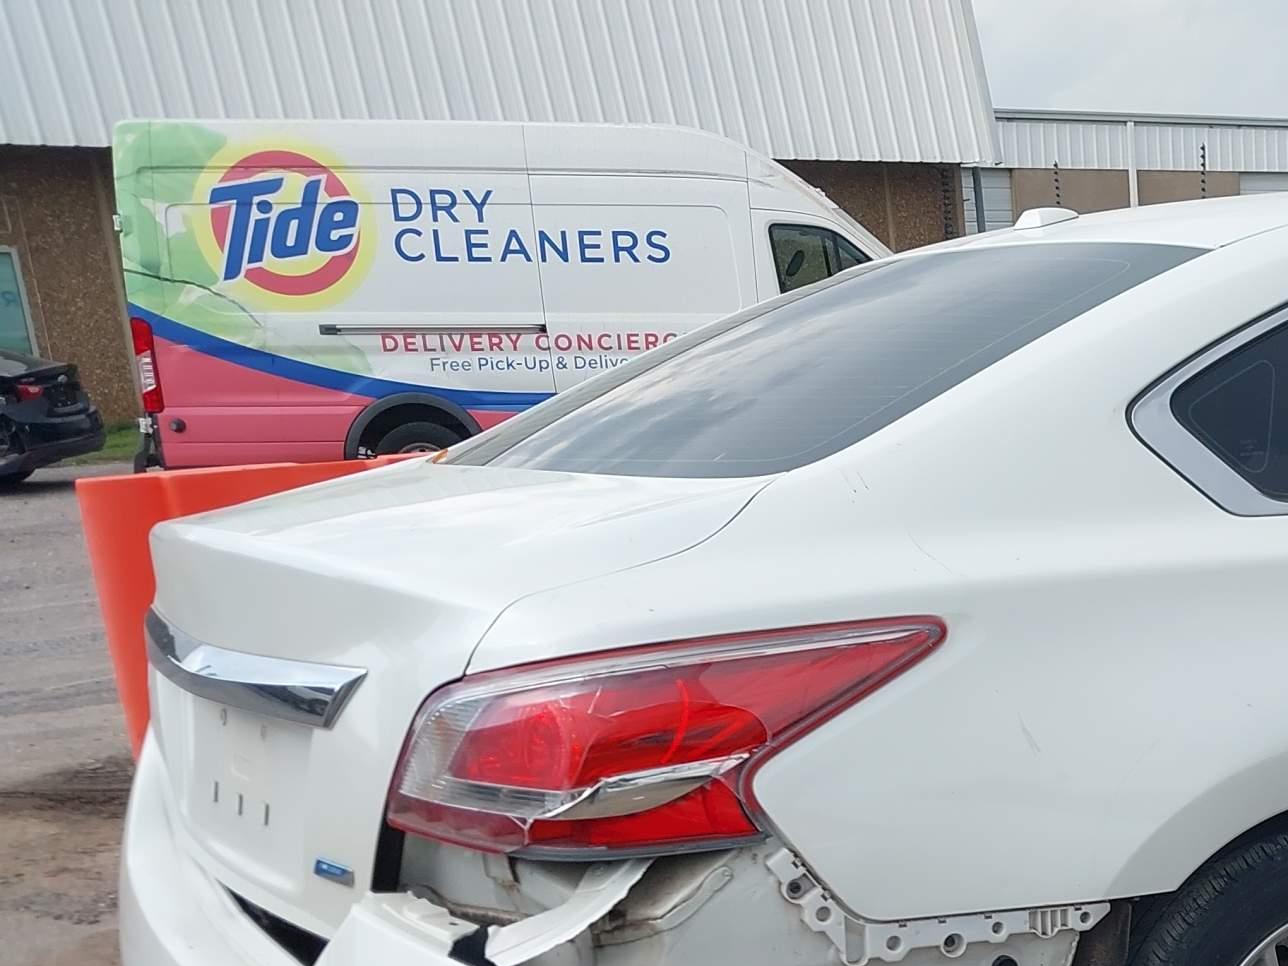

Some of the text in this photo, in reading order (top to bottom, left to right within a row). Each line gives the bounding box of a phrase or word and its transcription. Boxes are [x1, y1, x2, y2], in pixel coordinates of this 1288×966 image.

[390, 187, 493, 223] DRY
[209, 177, 359, 281] Tide
[394, 228, 671, 263] CLEANERS
[380, 332, 687, 353] DELIVERY CONCIER
[430, 357, 472, 372] Free
[478, 355, 550, 372] Pick-Up
[556, 356, 569, 370] &
